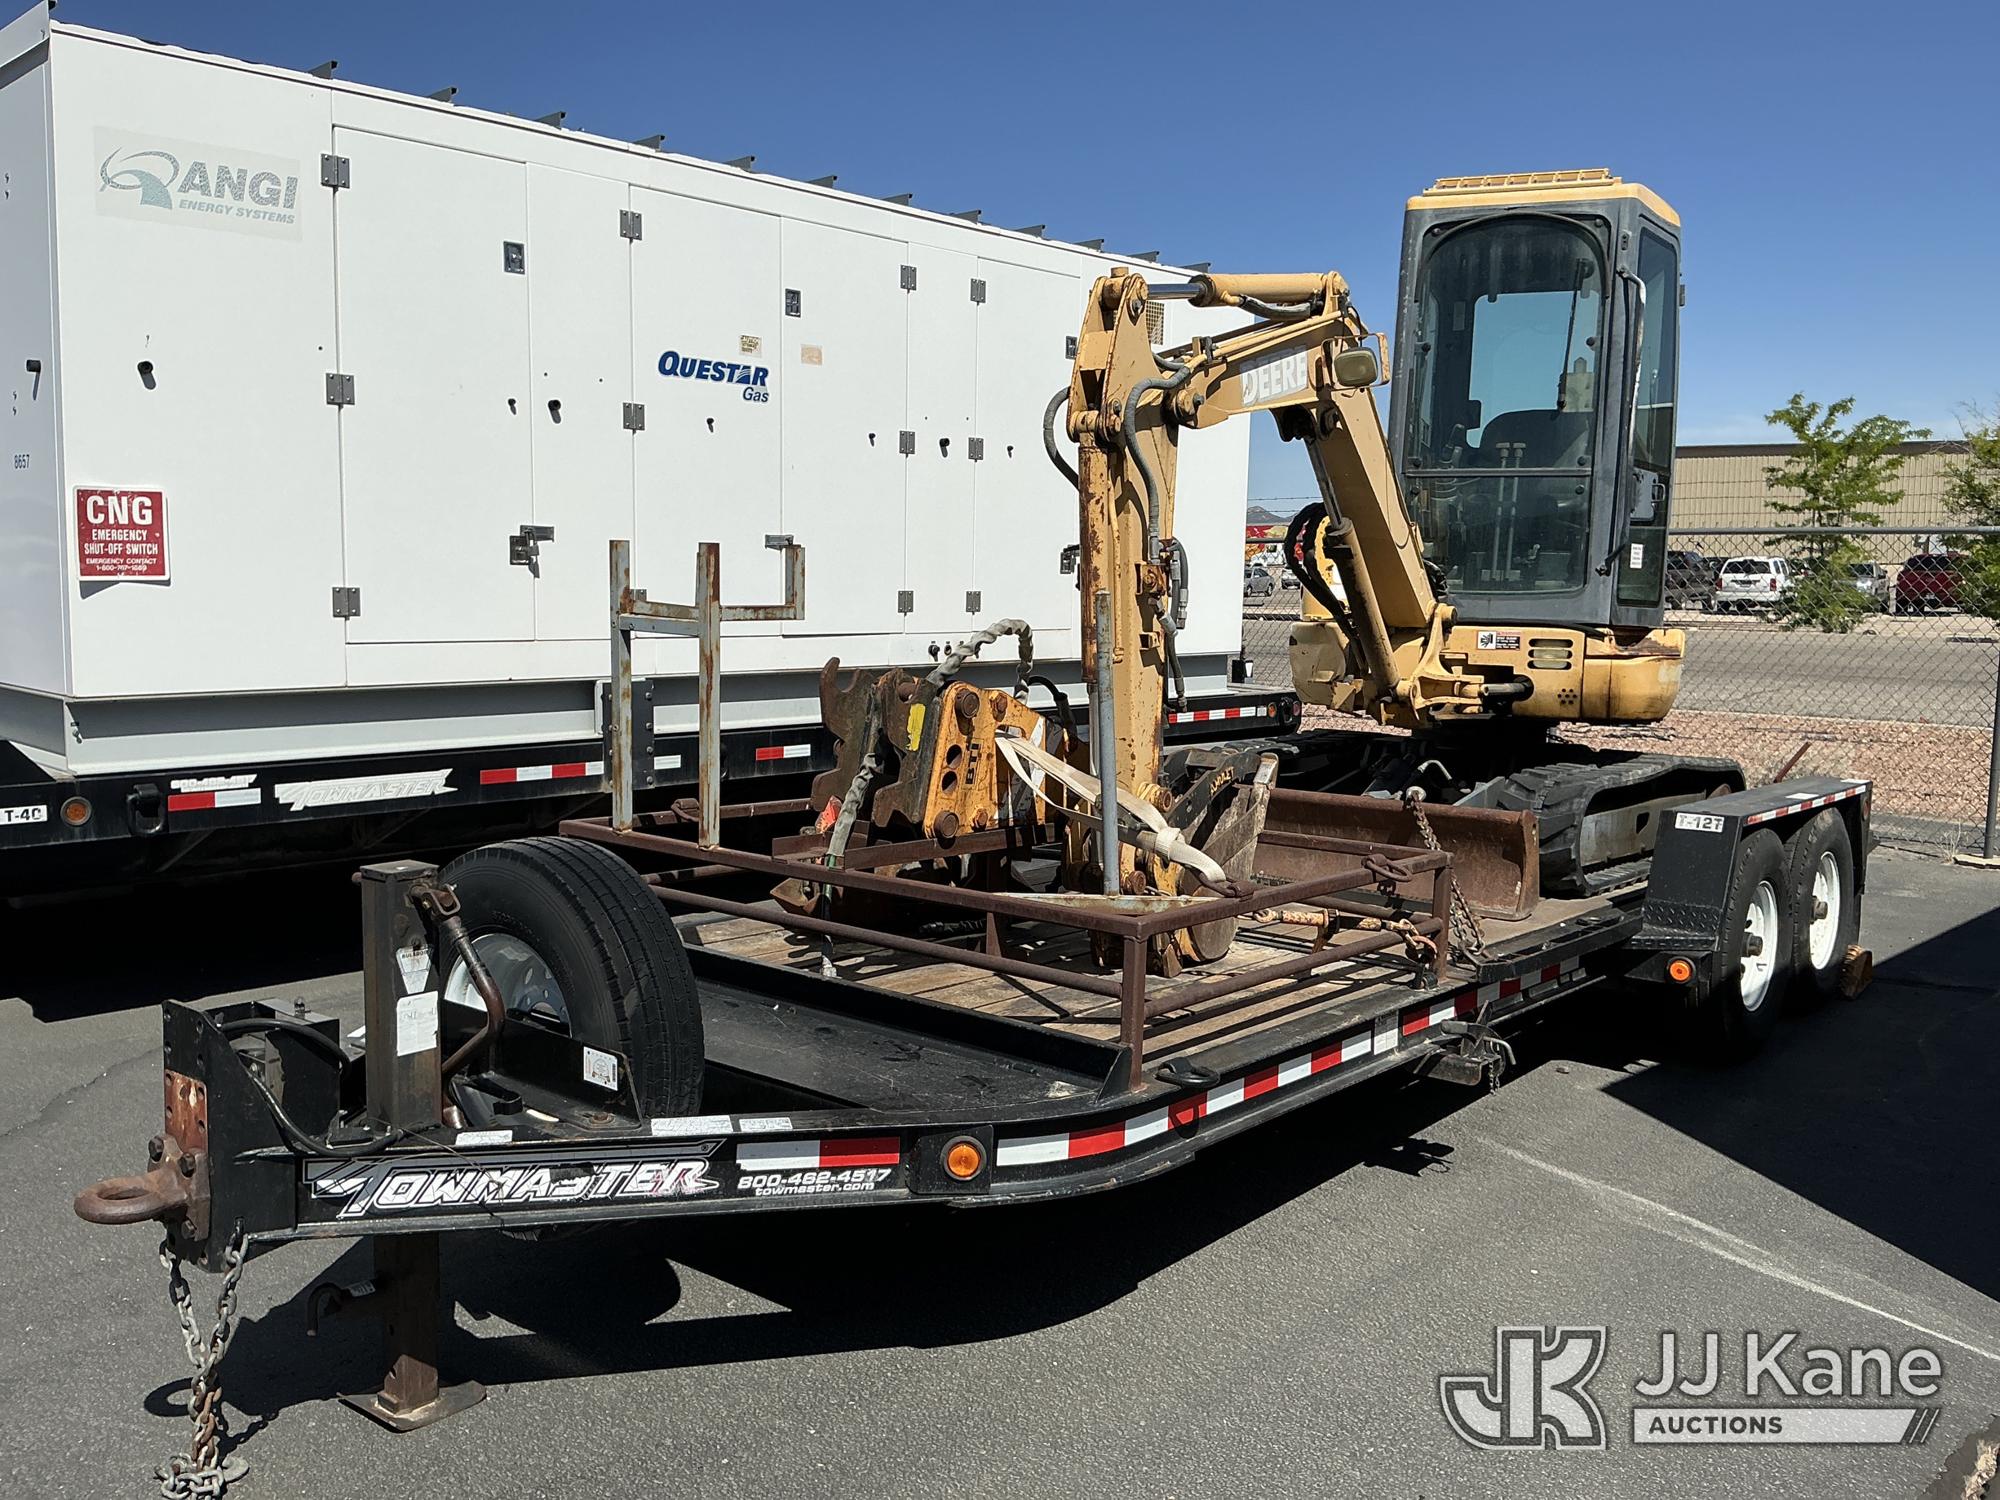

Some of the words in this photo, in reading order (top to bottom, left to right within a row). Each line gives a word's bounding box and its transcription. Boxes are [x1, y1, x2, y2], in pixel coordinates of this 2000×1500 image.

[177, 161, 299, 209] ANGI
[179, 200, 232, 216] ENERGY
[236, 206, 295, 224] SYSTEMS
[658, 351, 769, 386] QUESTAR
[1241, 345, 1308, 405] DEERE
[742, 386, 769, 402] Gas
[14, 454, 30, 469] 8657
[86, 495, 153, 525] CNG
[92, 529, 148, 541] EMERGENCY
[84, 543, 123, 555] SHUT-OFF
[126, 543, 158, 555] SWITCH
[275, 768, 458, 811] TOWMASTER
[1679, 814, 1723, 830] T-12T
[737, 1168, 892, 1190] 800-462-4517
[755, 1181, 875, 1196] towmaster.com
